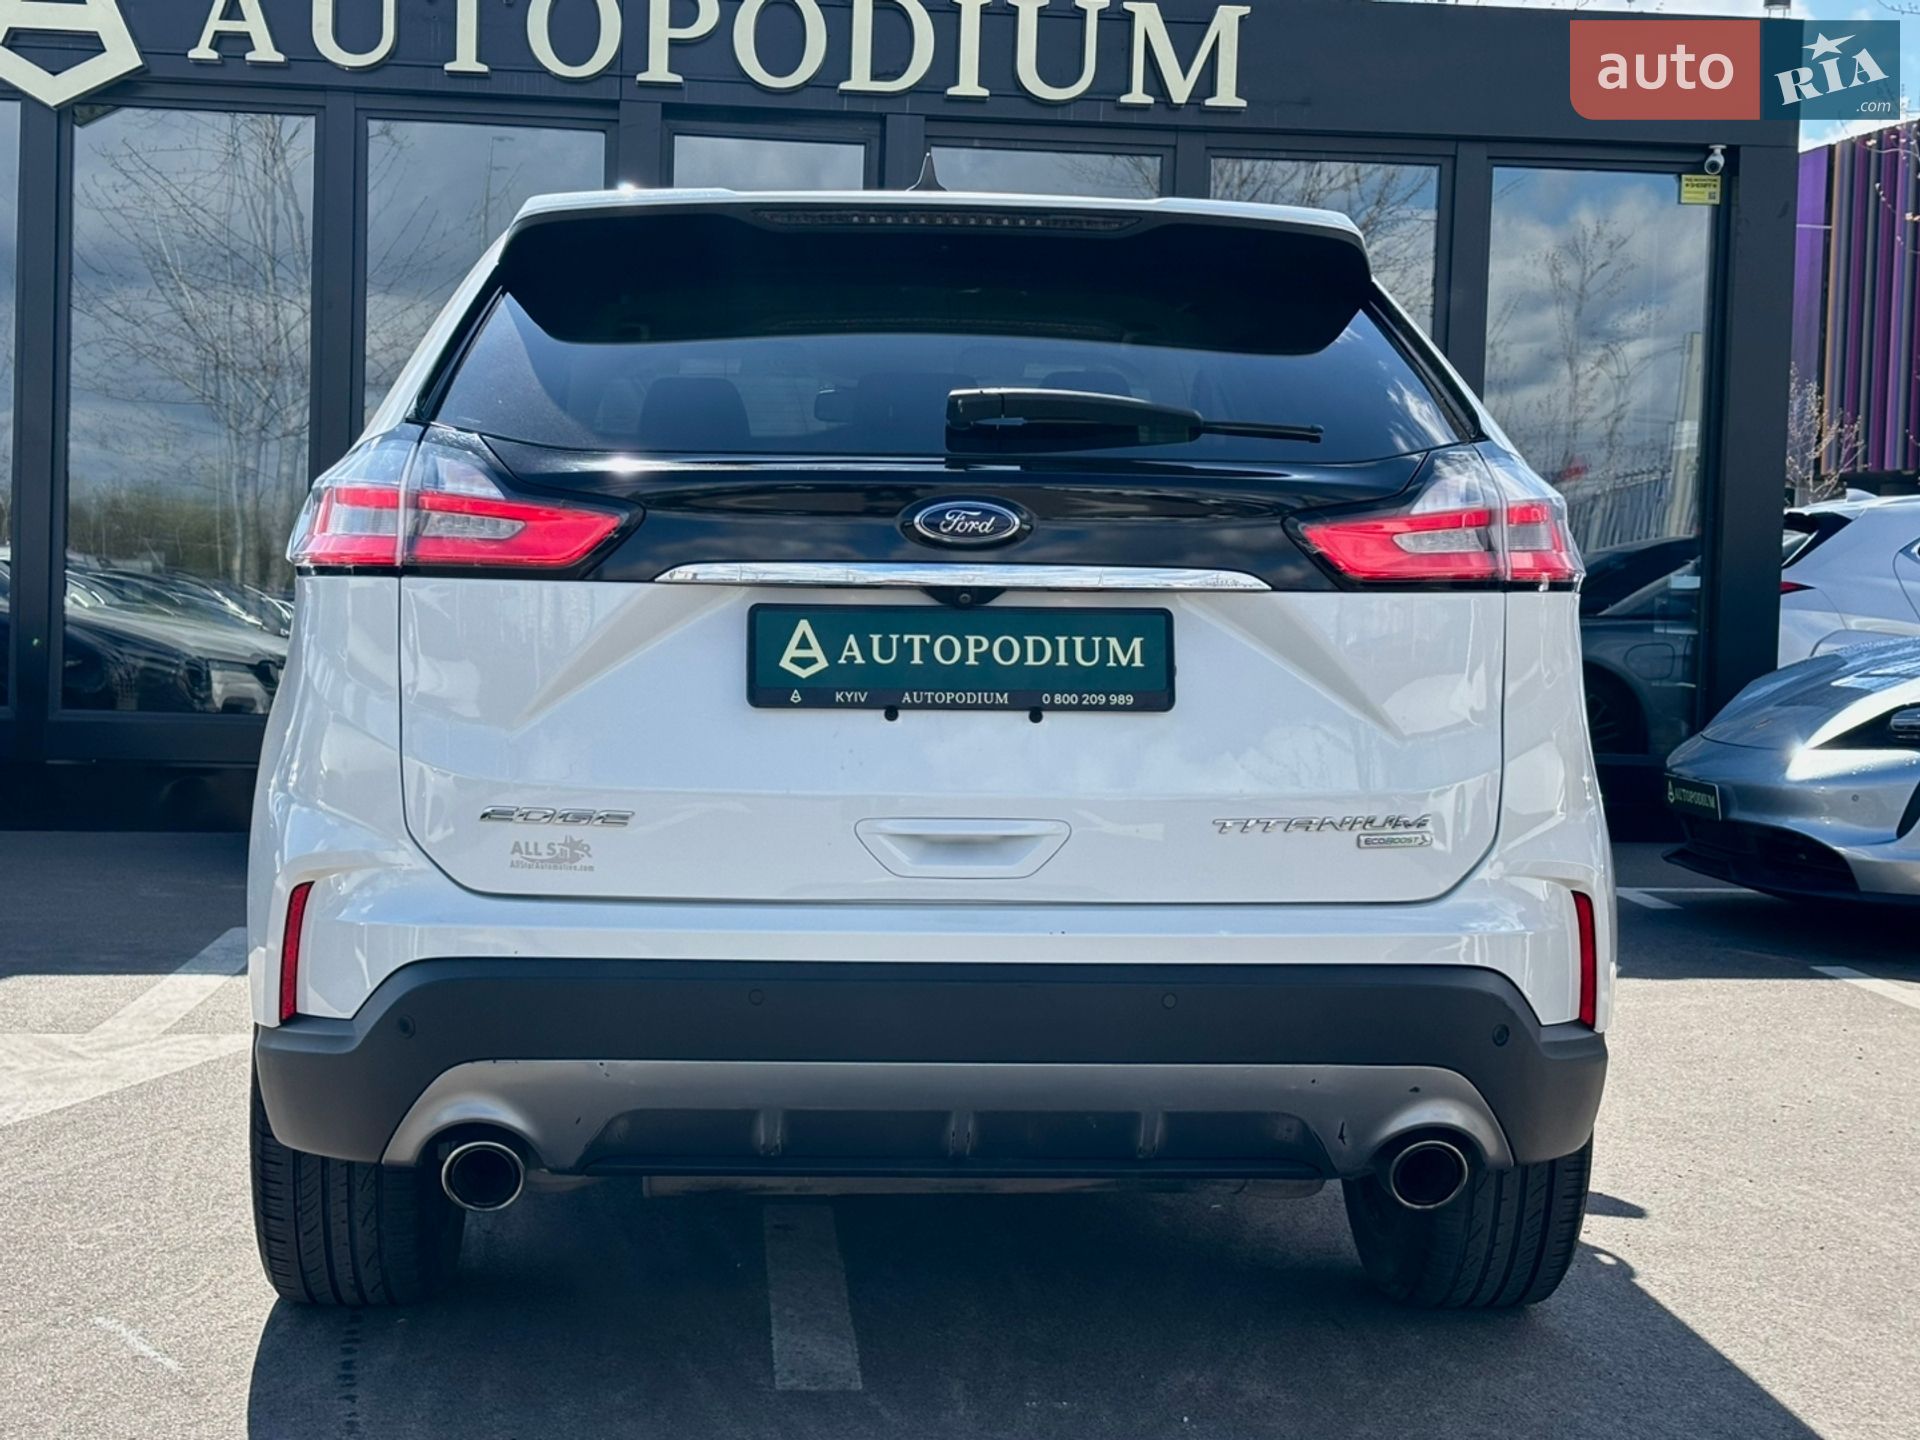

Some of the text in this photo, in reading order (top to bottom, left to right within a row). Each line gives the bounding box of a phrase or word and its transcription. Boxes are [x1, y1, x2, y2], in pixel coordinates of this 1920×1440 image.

[939, 509, 996, 534] Ford
[838, 633, 1145, 667] AUTOPODIUM
[835, 691, 868, 703] KYIV
[902, 692, 1010, 705] AUTOPODIUM
[1042, 694, 1134, 706] 0 800 209 989
[480, 805, 635, 827] EDGE
[1212, 814, 1431, 833] TITANIUM
[510, 840, 542, 857] ALL
